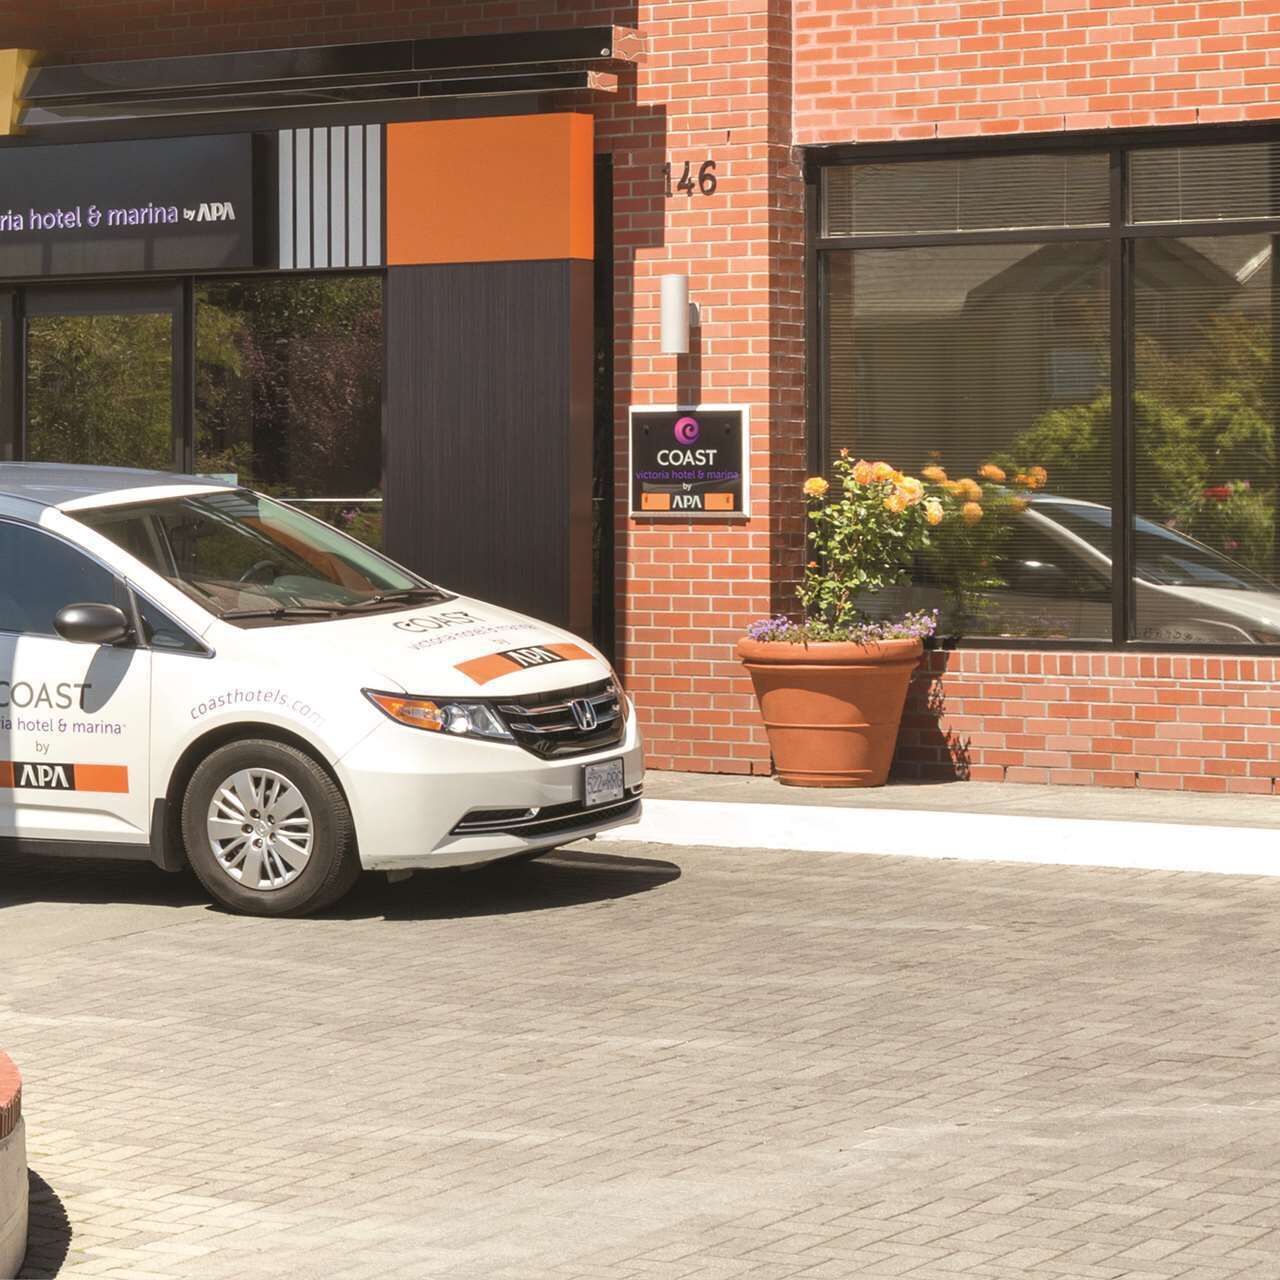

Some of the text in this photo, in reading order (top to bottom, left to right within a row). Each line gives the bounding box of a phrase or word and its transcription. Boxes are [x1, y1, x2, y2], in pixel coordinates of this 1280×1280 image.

[661, 160, 717, 198] 146
[30, 206, 82, 230] hotel
[87, 205, 102, 227] &
[107, 202, 178, 226] marina
[183, 207, 195, 221] by
[197, 201, 235, 222] APA
[656, 449, 718, 466] COAST
[635, 470, 739, 480] victoria hotel & marina
[682, 482, 693, 491] by
[672, 494, 703, 509] APA
[393, 610, 487, 633] COAST
[505, 647, 562, 668] APA
[190, 688, 327, 728] coasthotels.com
[17, 717, 54, 732] hotel
[58, 718, 67, 733] &
[72, 719, 122, 735] marina
[35, 740, 50, 755] by
[20, 764, 70, 788] APA
